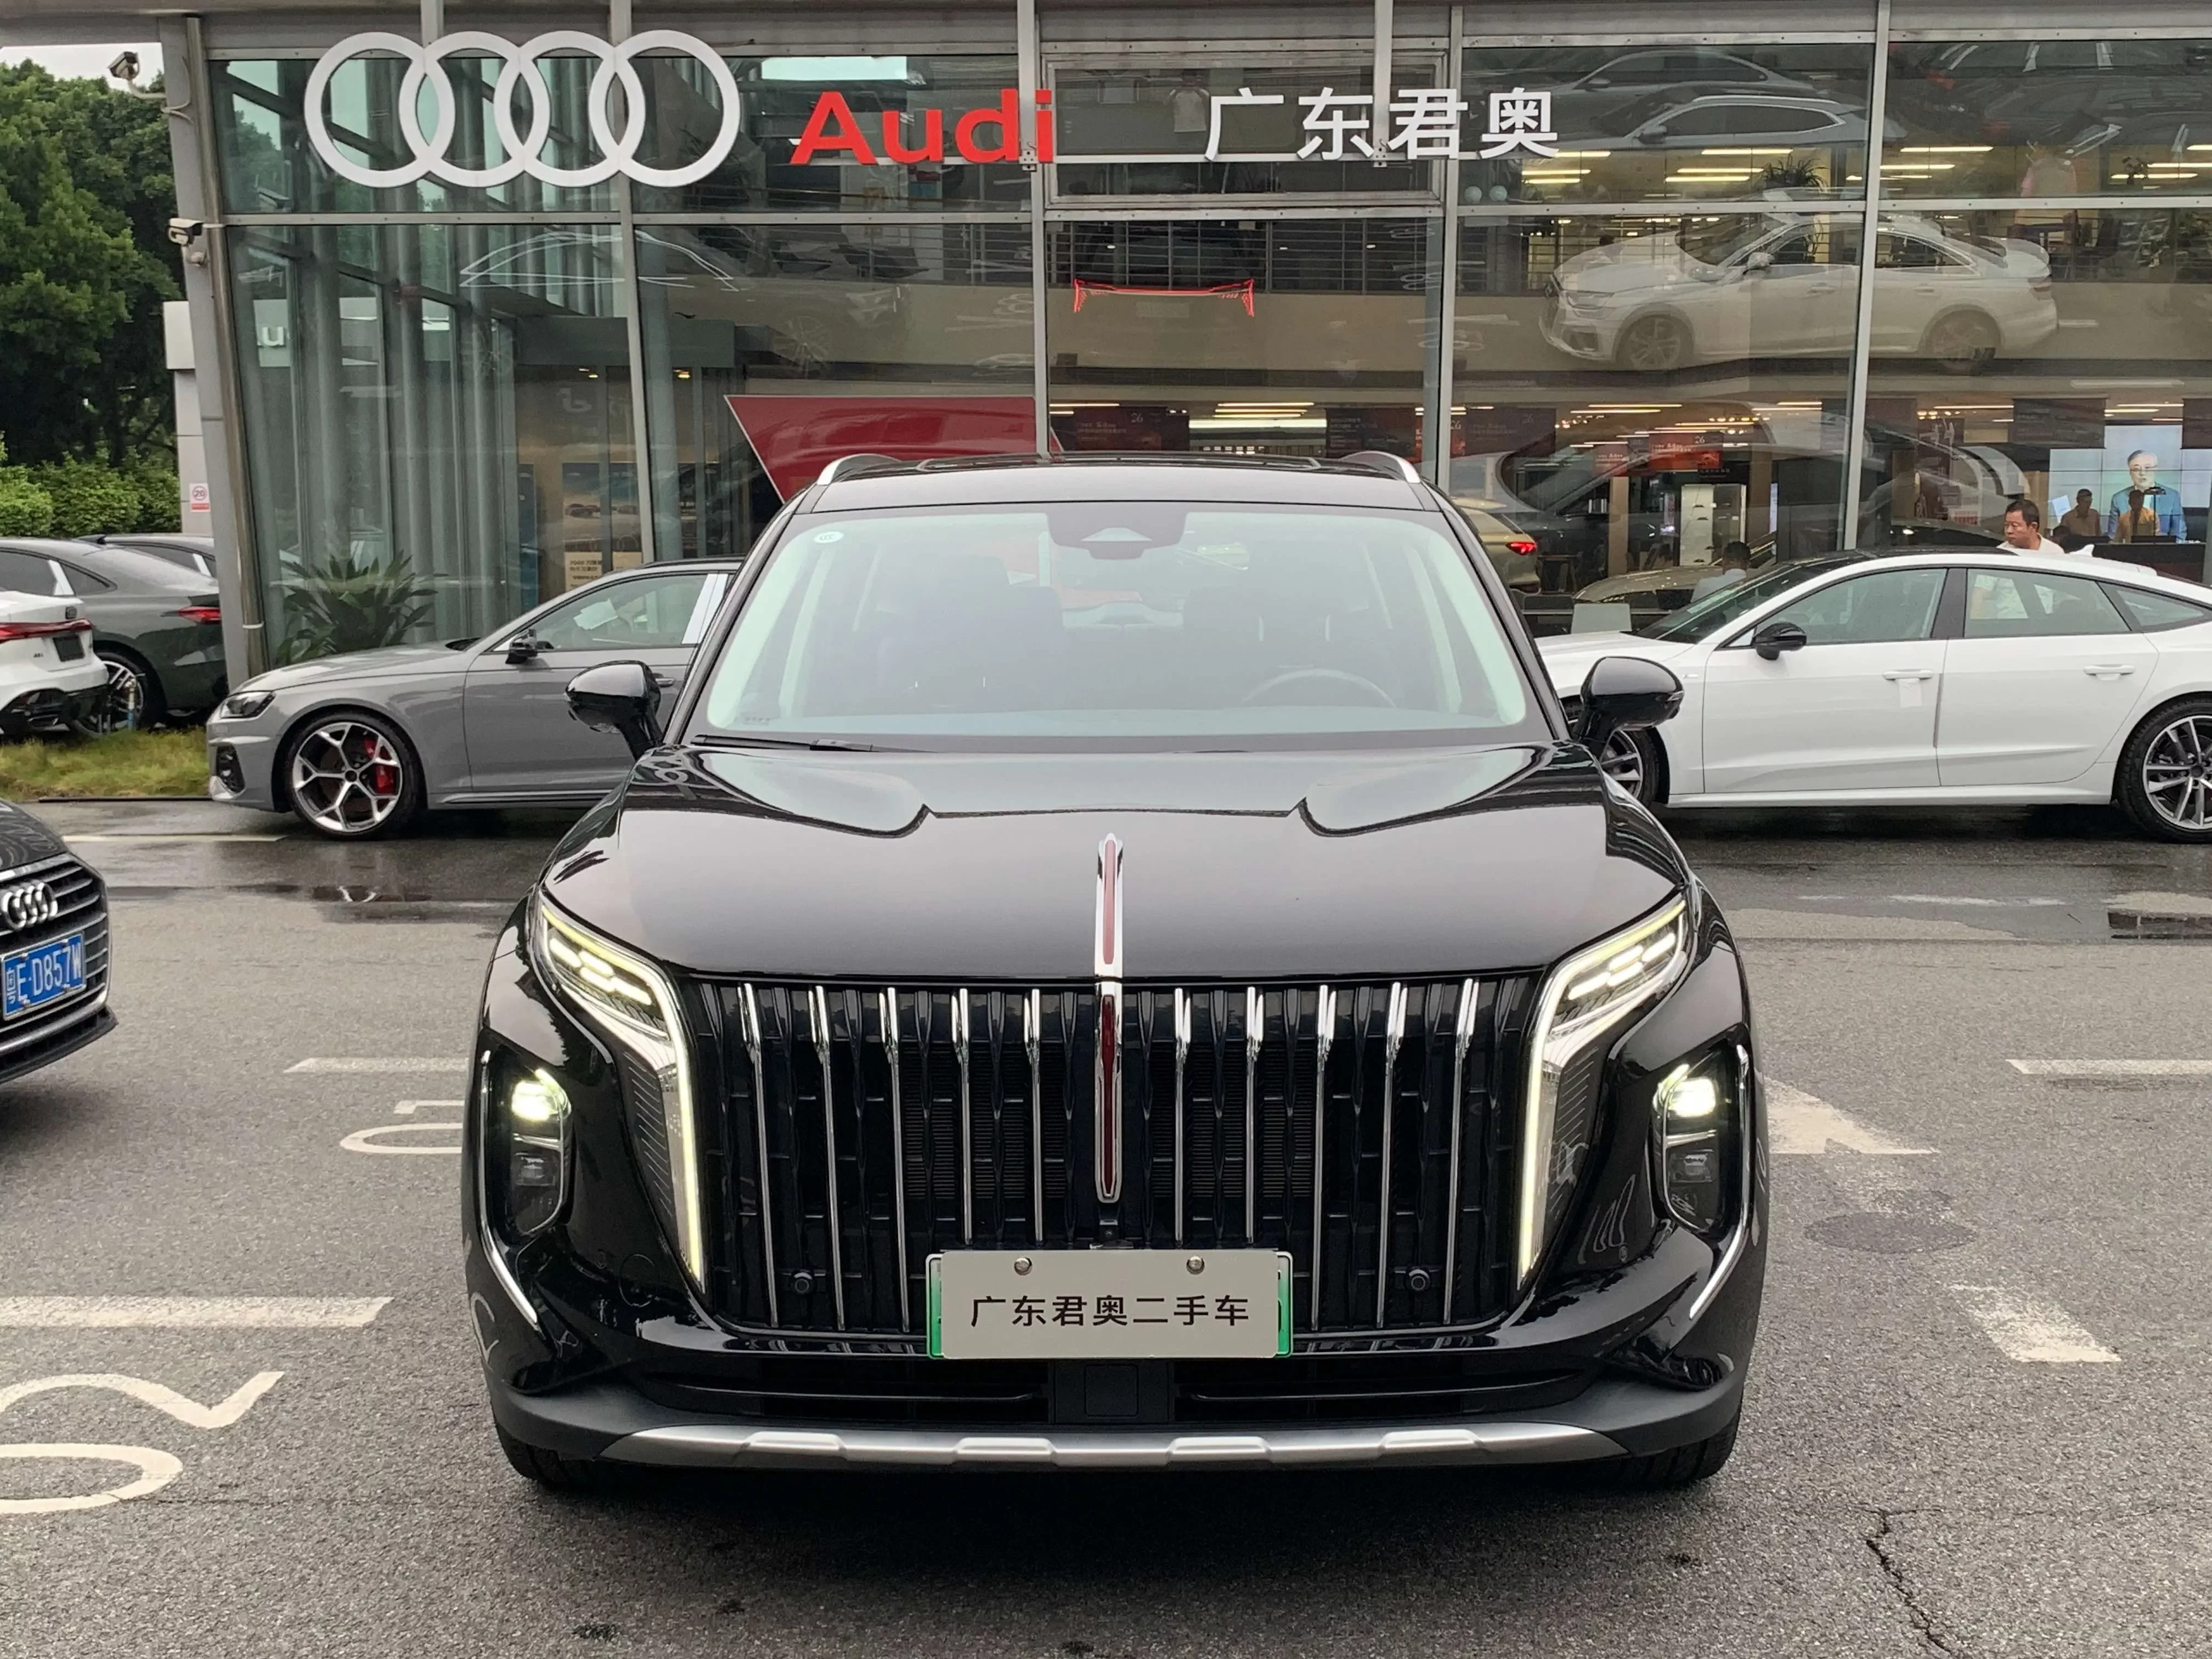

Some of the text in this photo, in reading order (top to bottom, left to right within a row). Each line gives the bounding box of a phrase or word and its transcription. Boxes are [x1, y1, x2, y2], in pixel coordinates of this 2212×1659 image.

[790, 88, 1053, 164] Audi
[1205, 87, 1559, 160] 广东君奥
[970, 1295, 1250, 1327] 广东君奥二手车
